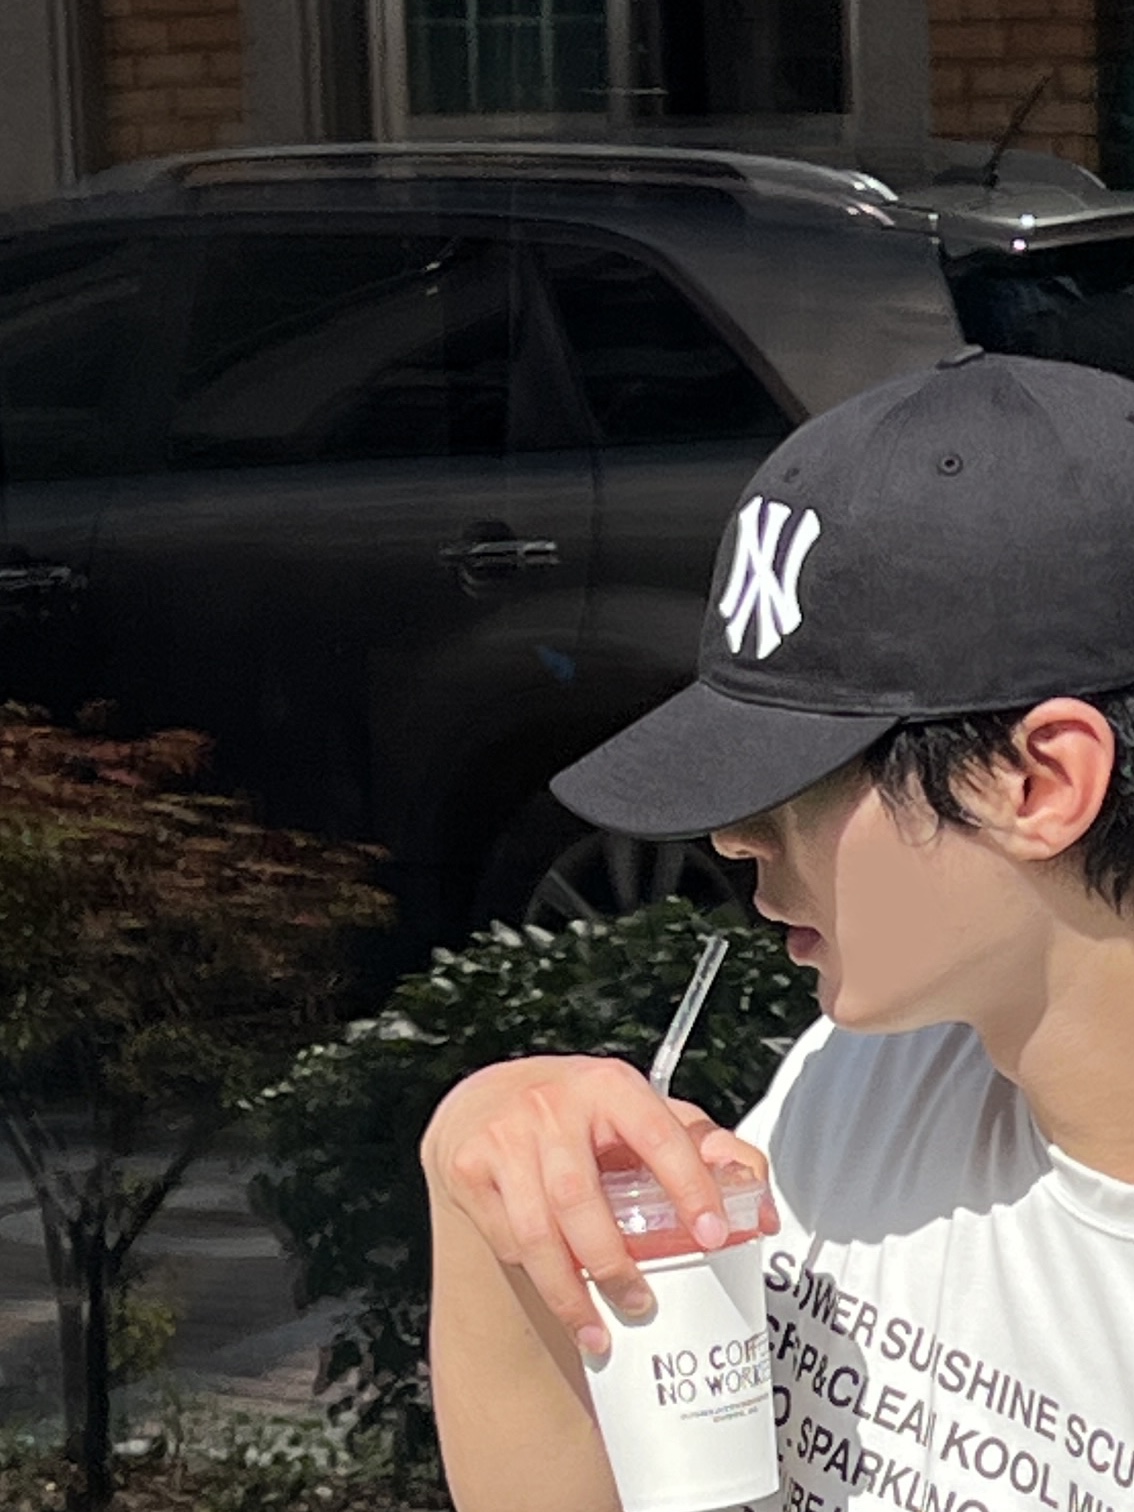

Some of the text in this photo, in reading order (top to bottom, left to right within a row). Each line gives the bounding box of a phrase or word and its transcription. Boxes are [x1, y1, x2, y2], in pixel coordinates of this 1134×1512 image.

[719, 496, 821, 659] NY
[652, 1349, 698, 1381] NO
[657, 1379, 697, 1406] NO
[940, 1421, 1060, 1510] KOOL
